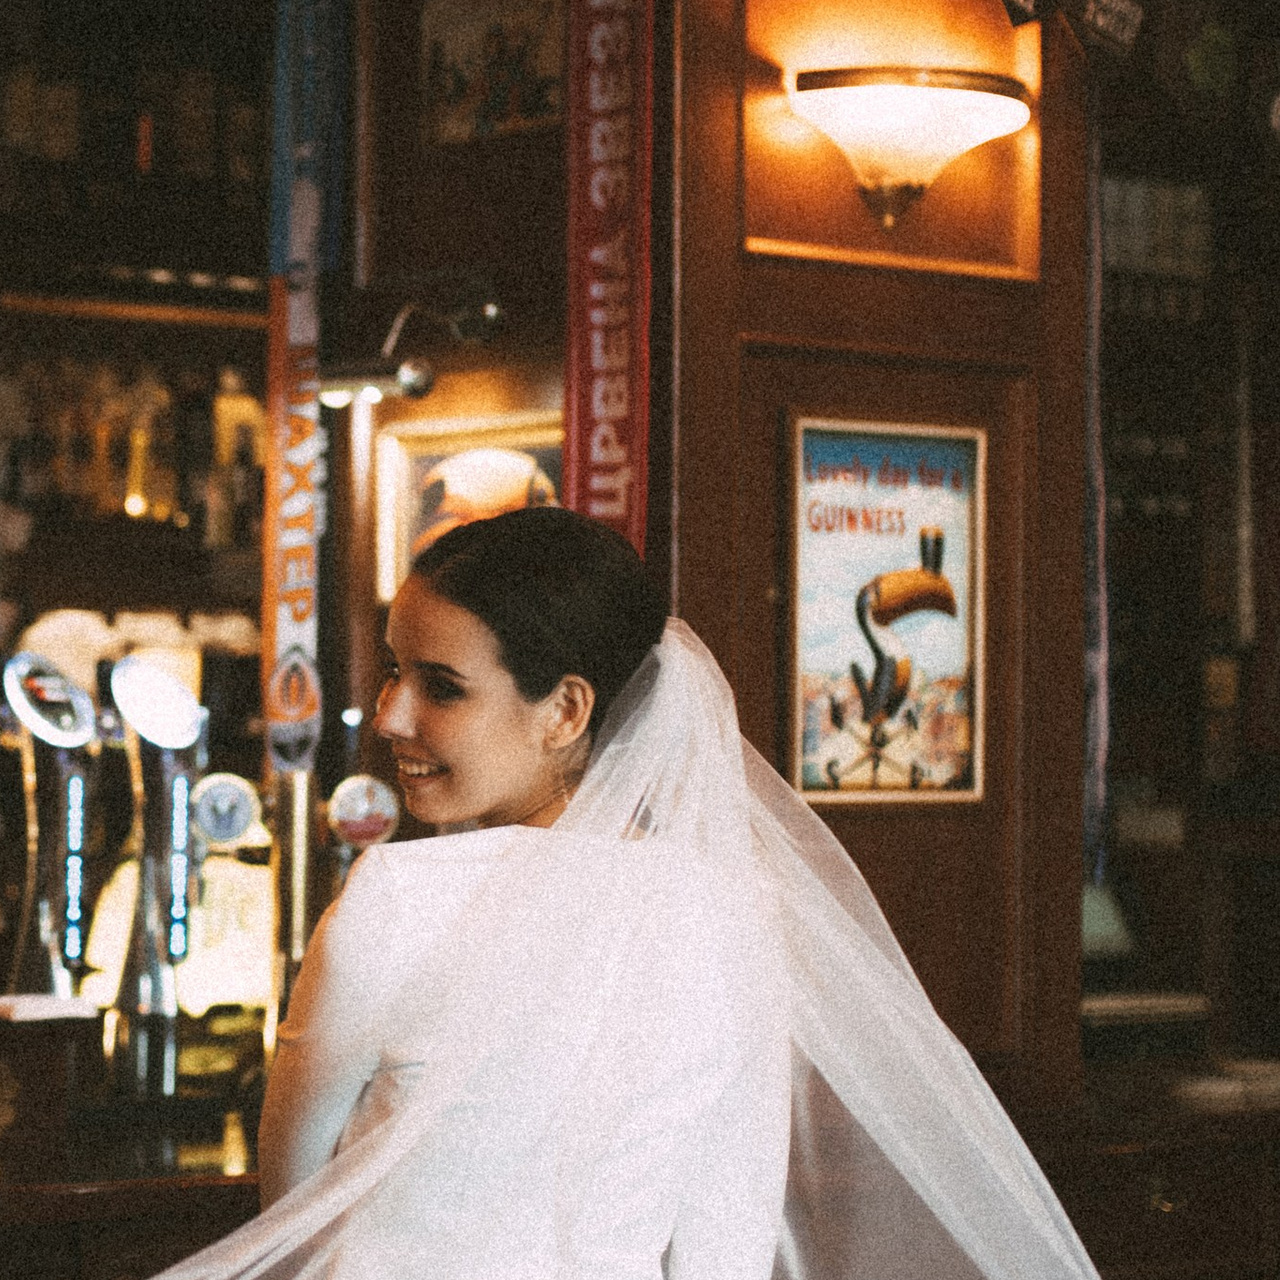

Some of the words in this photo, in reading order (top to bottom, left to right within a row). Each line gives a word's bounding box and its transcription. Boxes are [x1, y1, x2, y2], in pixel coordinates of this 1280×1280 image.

[276, 342, 317, 622] ШАХТЕР
[586, 226, 634, 520] ЦРВЕНА
[807, 498, 907, 537] GUINNESS
